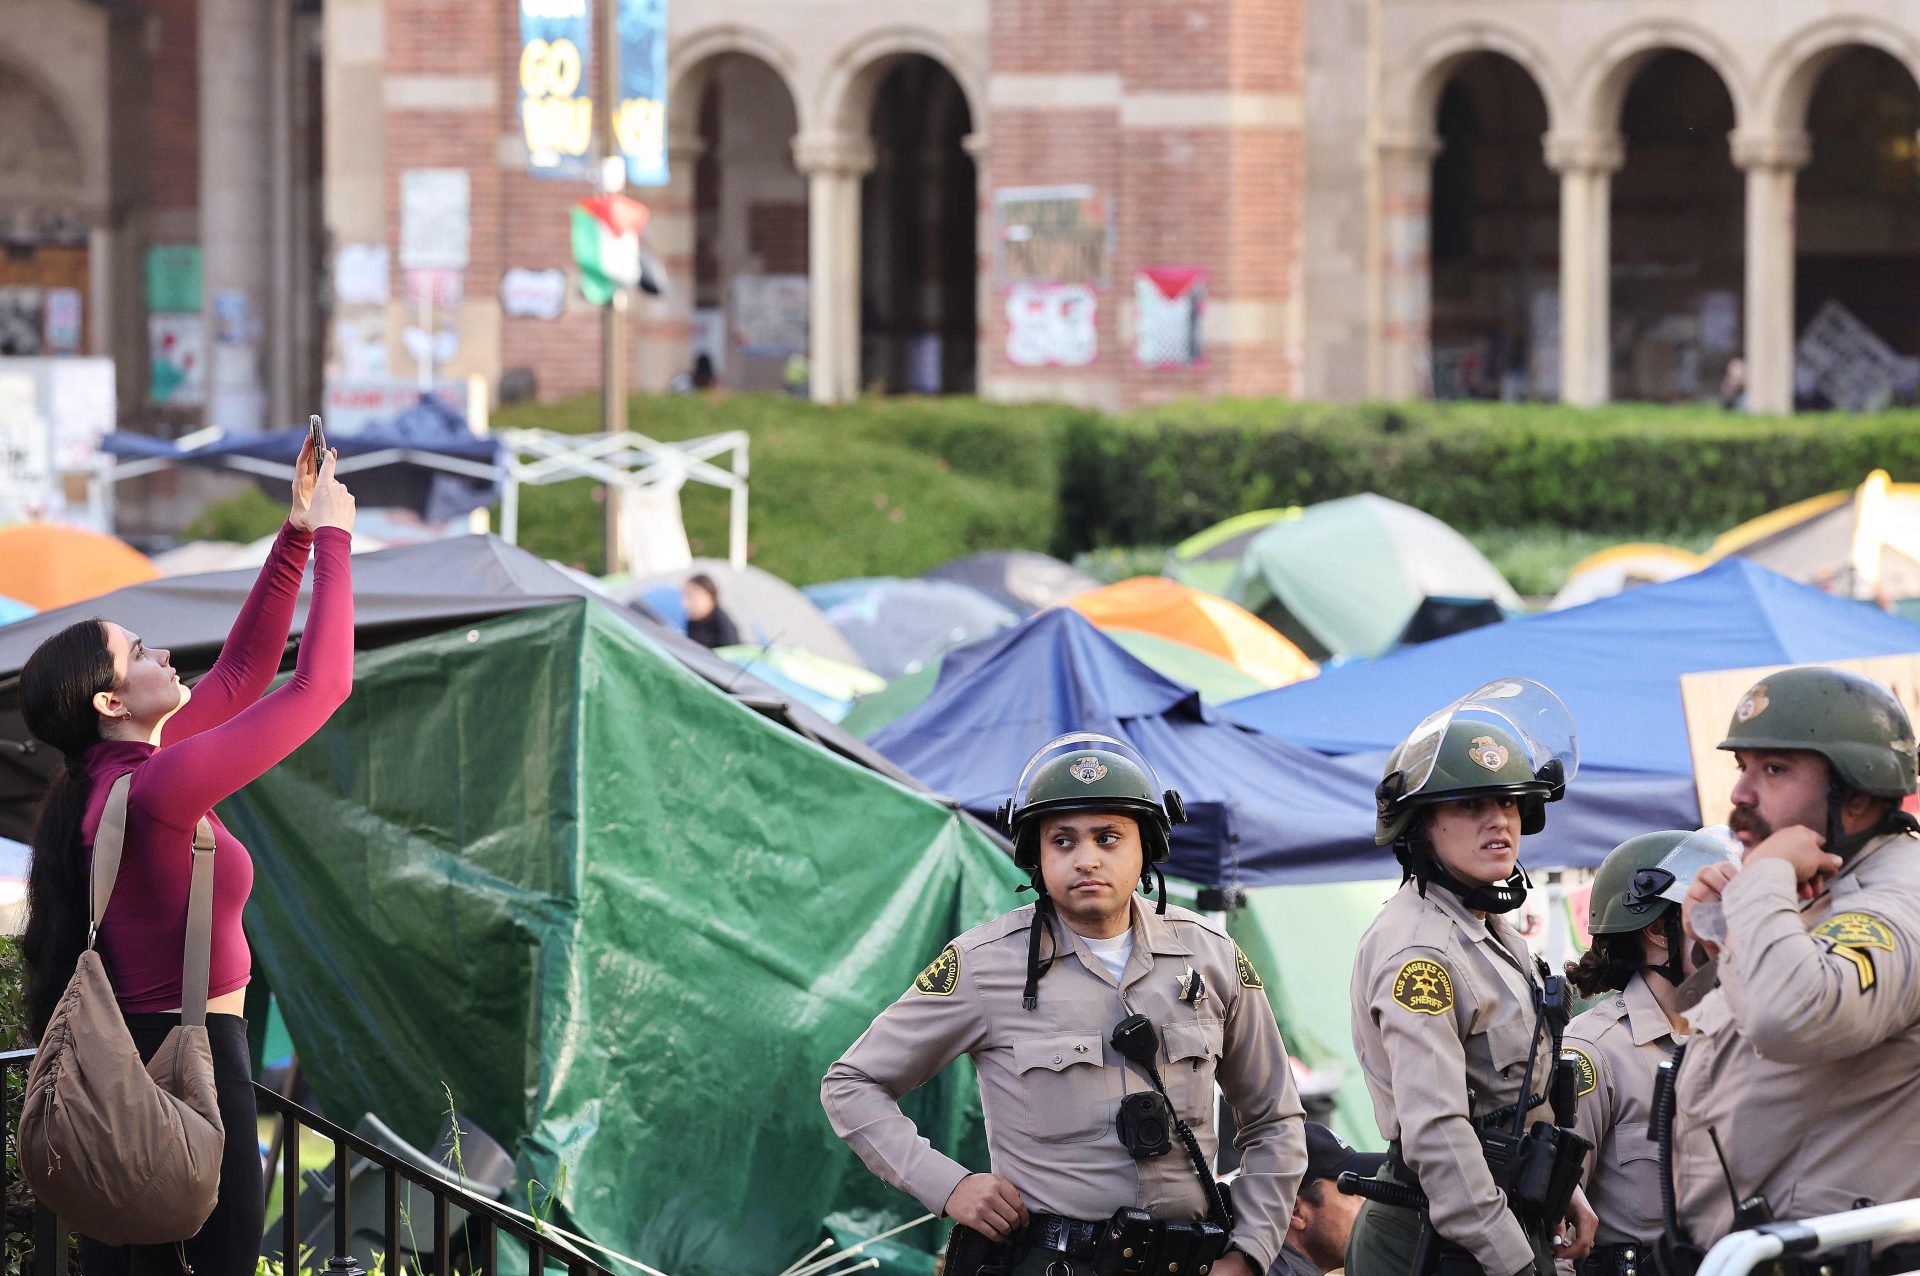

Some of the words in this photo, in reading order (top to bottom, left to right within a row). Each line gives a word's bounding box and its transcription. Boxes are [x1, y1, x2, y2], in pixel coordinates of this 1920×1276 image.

[942, 962, 957, 992] COUNTY
[1395, 979, 1406, 997] LOS
[1402, 962, 1438, 980] ANGELES
[1437, 971, 1452, 1003] COUNTY
[1410, 995, 1443, 1009] SHERIFF
[1578, 1055, 1593, 1085] COUNTY
